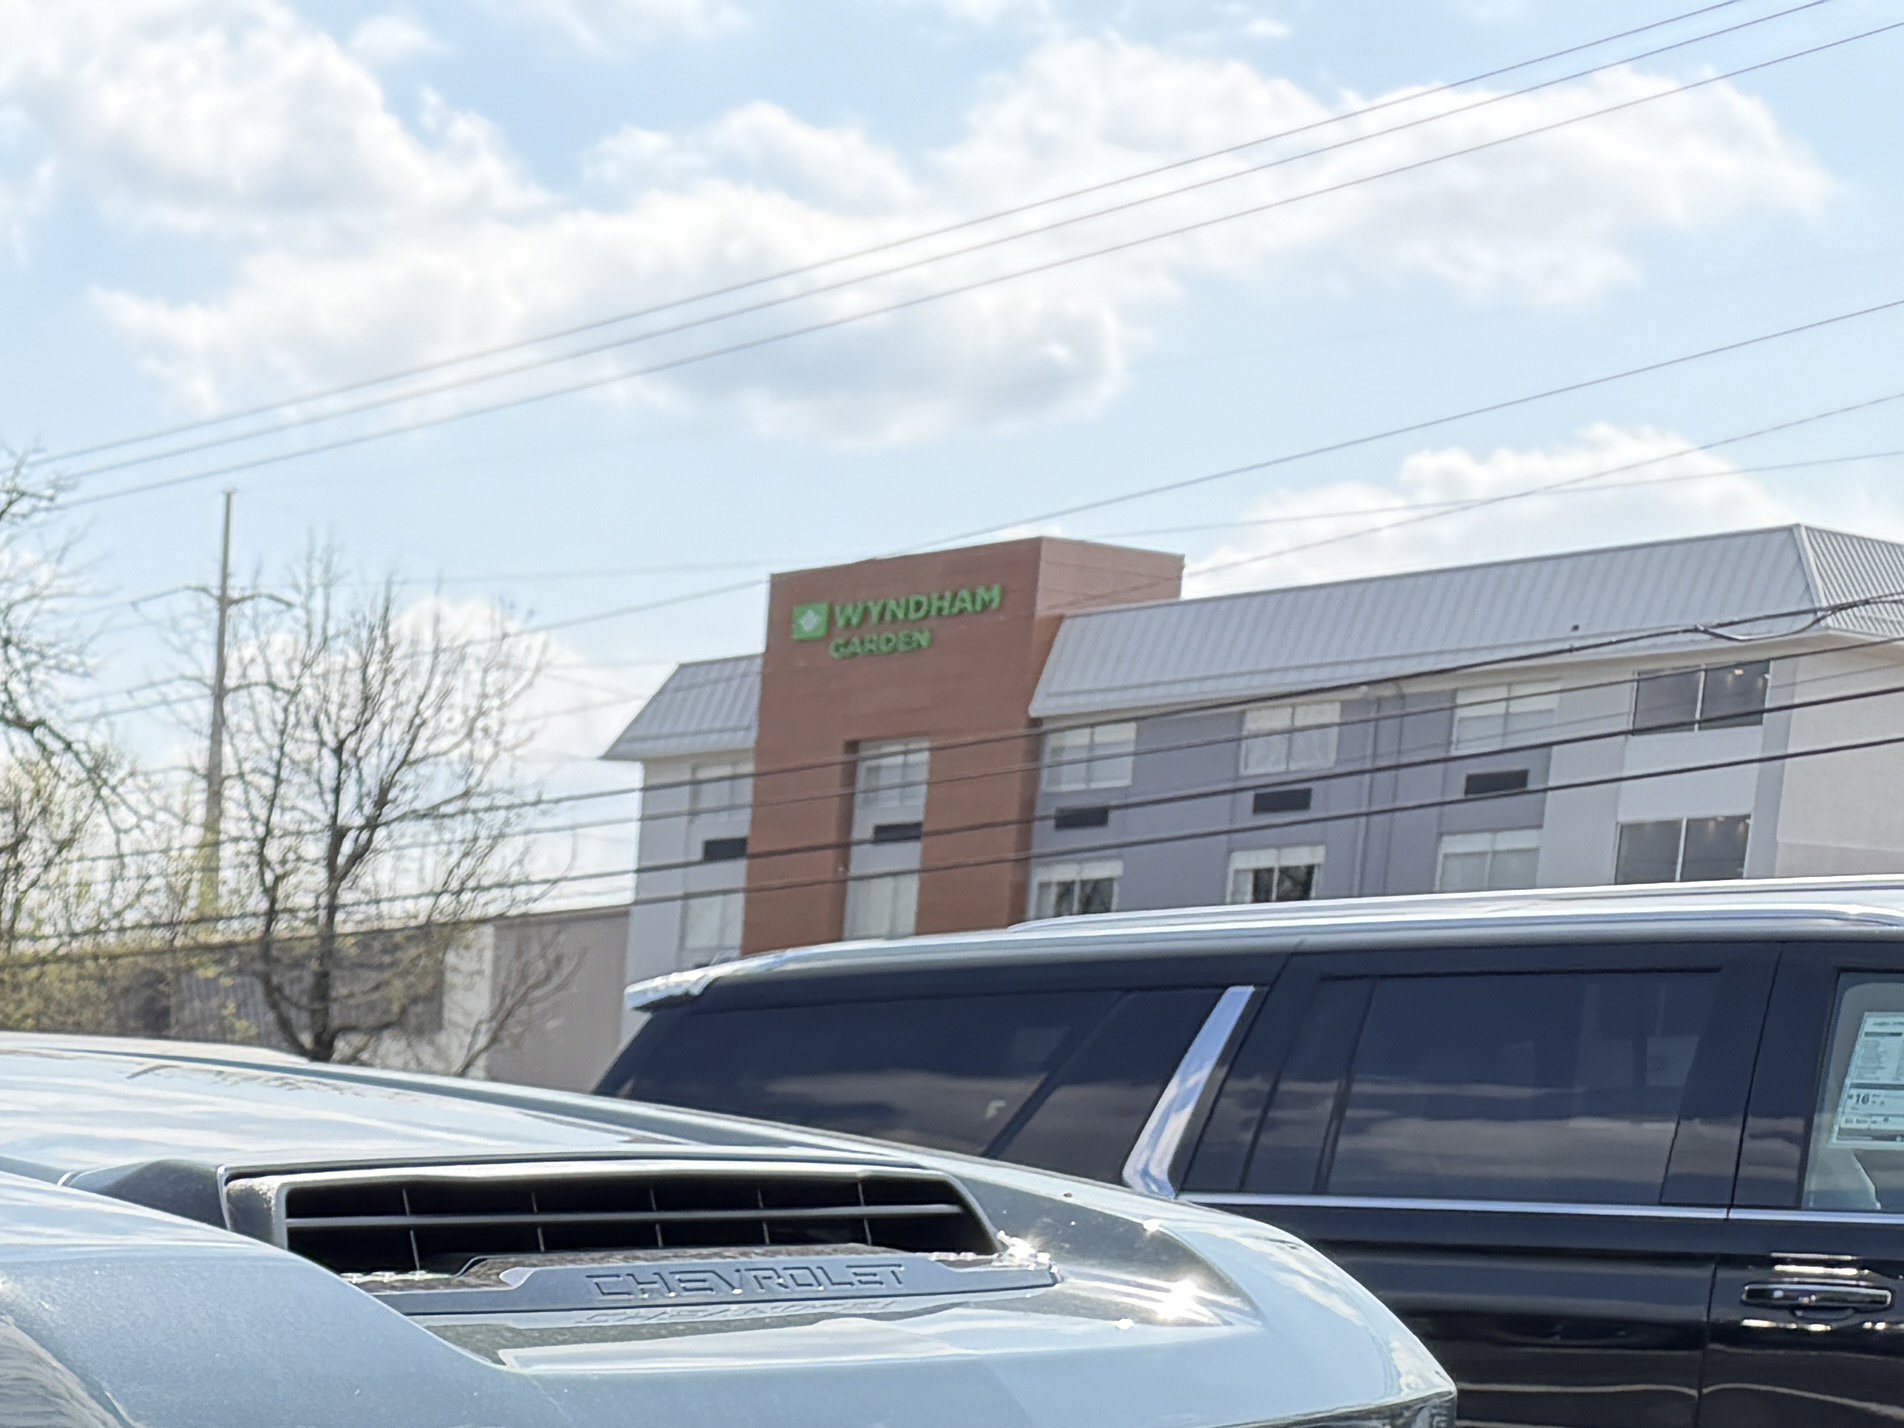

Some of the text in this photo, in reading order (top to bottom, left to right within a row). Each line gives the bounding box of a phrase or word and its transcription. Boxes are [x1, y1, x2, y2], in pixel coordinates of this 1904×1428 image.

[833, 583, 1003, 629] WYNDHAM
[828, 629, 933, 660] GARDEN
[585, 1263, 904, 1297] CHEVROLET
